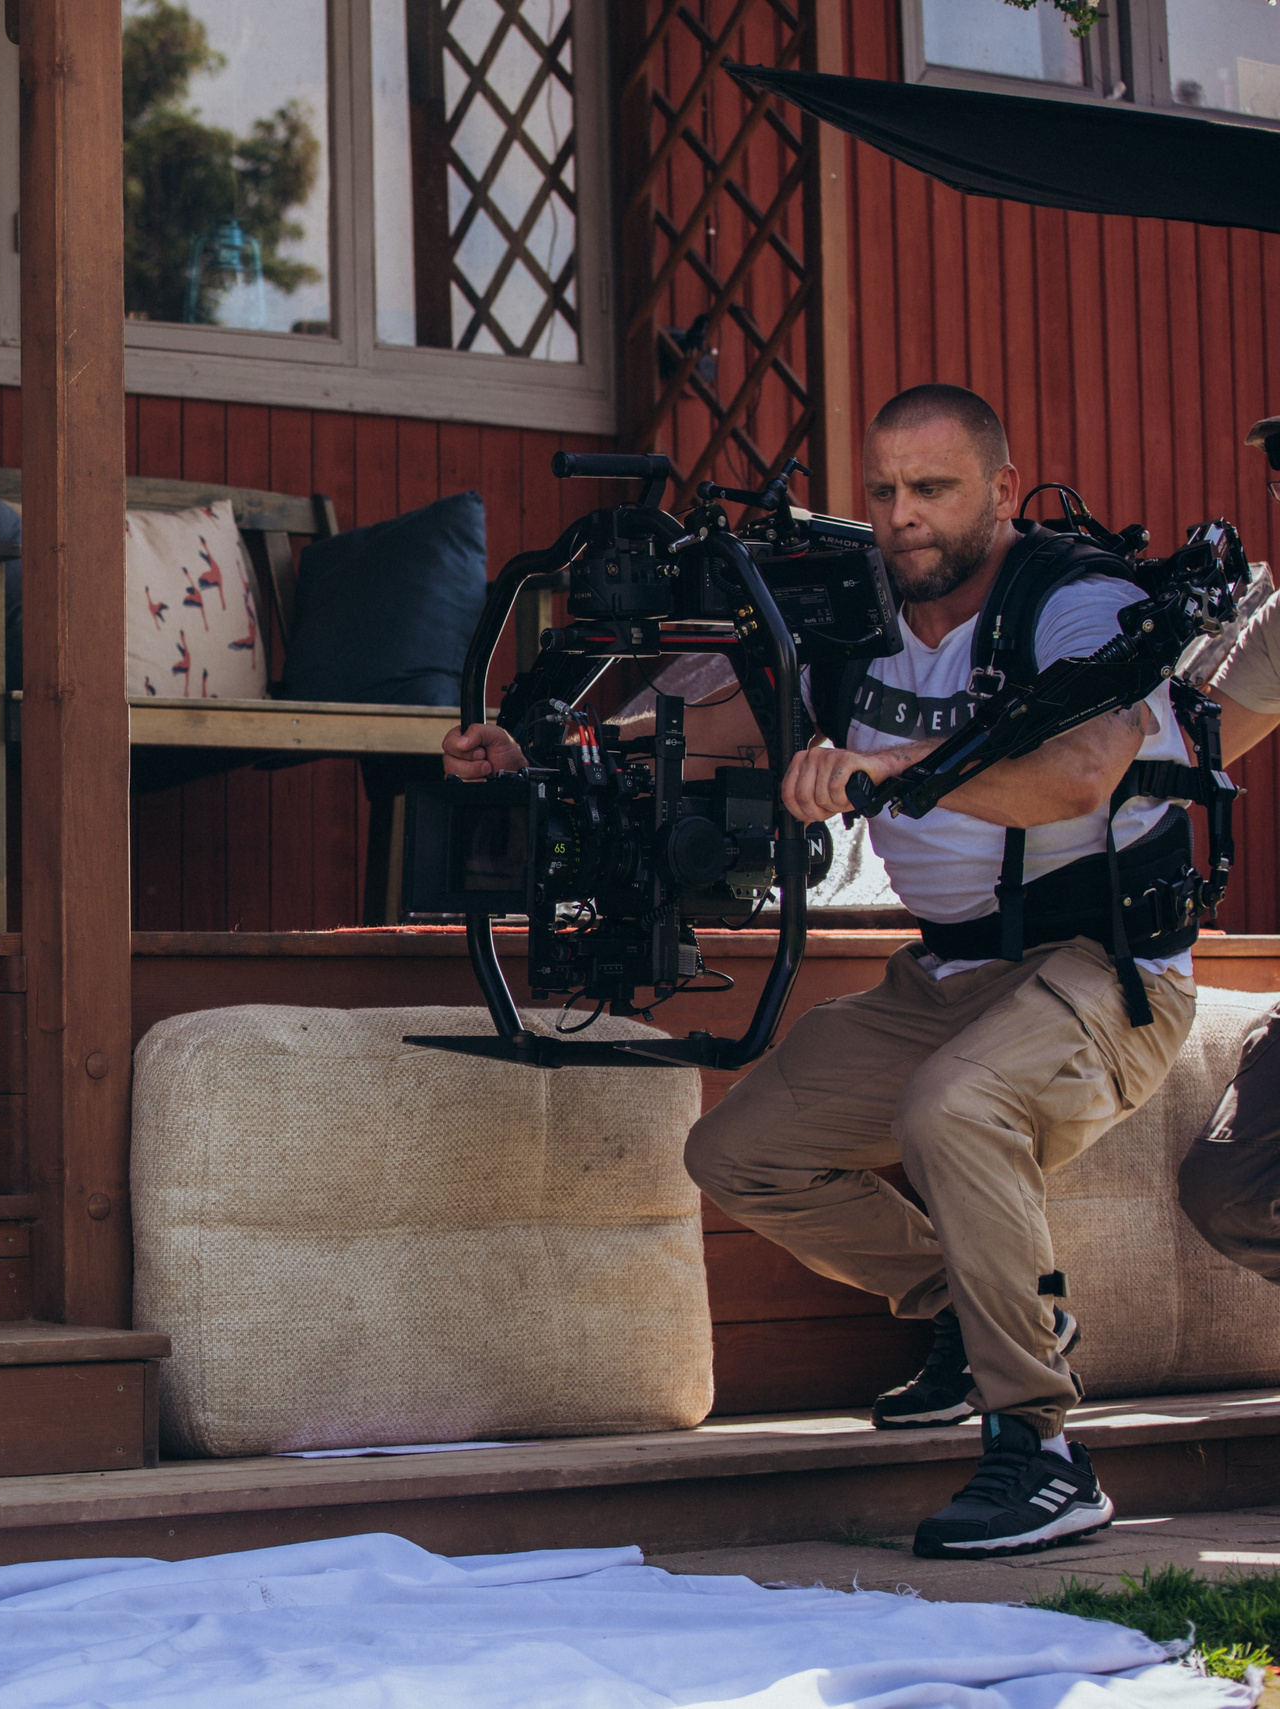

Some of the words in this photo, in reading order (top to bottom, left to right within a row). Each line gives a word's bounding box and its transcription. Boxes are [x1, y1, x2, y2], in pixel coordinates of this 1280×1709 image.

[818, 535, 860, 549] ARMOR
[1058, 714, 1079, 726] ULTIMATE
[1080, 706, 1097, 716] GIMBAL
[1097, 696, 1117, 707] SUPPORT
[554, 842, 566, 854] 65
